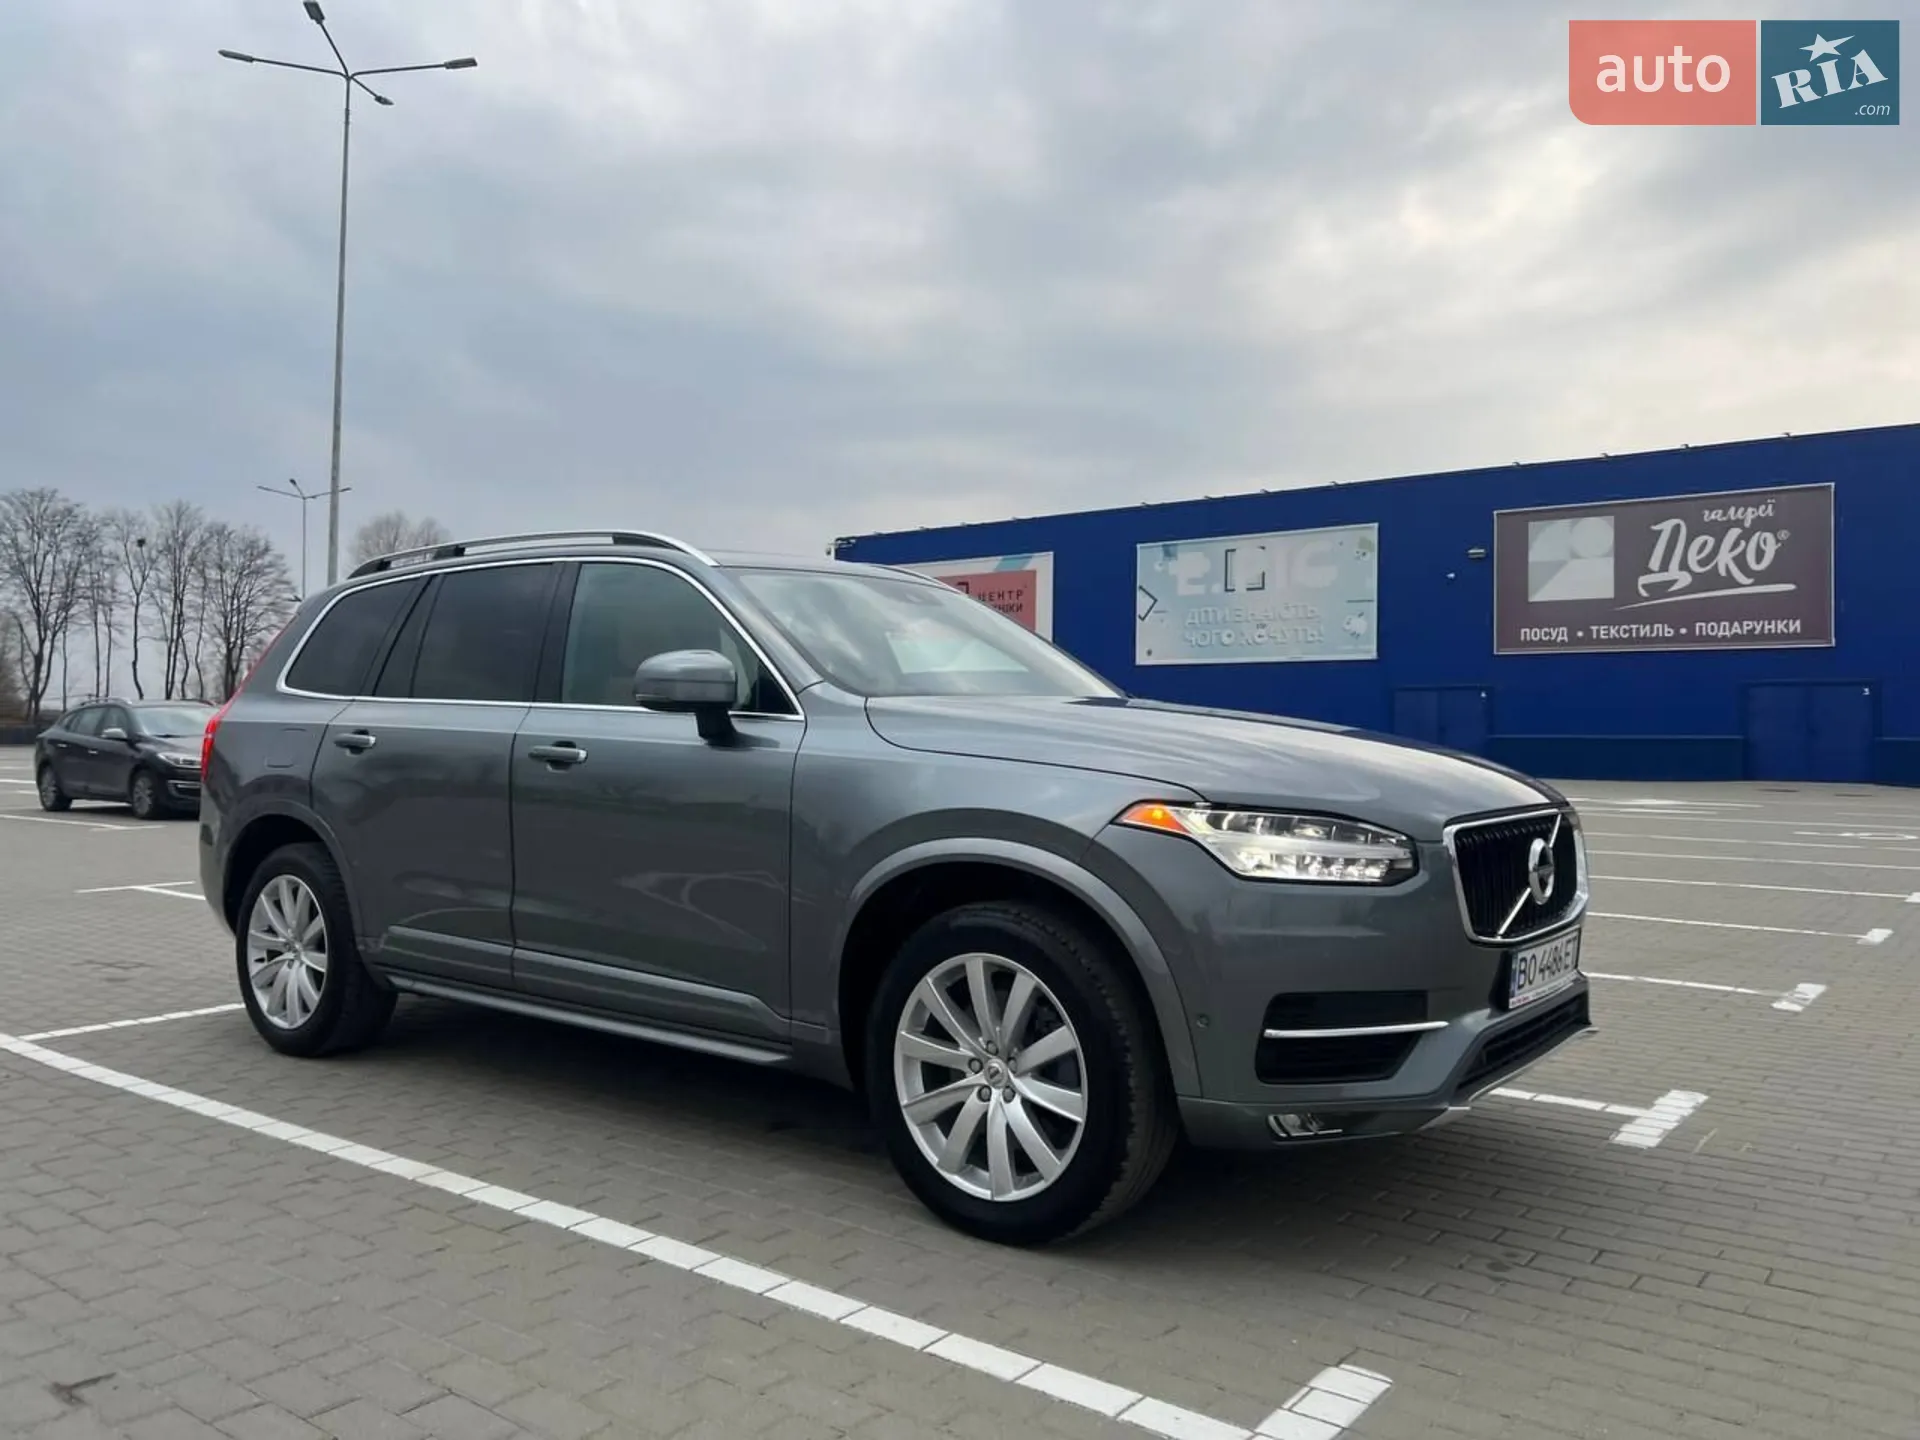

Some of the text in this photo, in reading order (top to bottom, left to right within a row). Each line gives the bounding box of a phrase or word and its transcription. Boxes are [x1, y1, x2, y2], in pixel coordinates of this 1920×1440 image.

[978, 589, 1024, 602] ЦЕНТР
[1520, 619, 1801, 643] ПОСУД ТЕКСТИЛЬ ПОДАРУНКИ
[1517, 953, 1537, 990] BO
